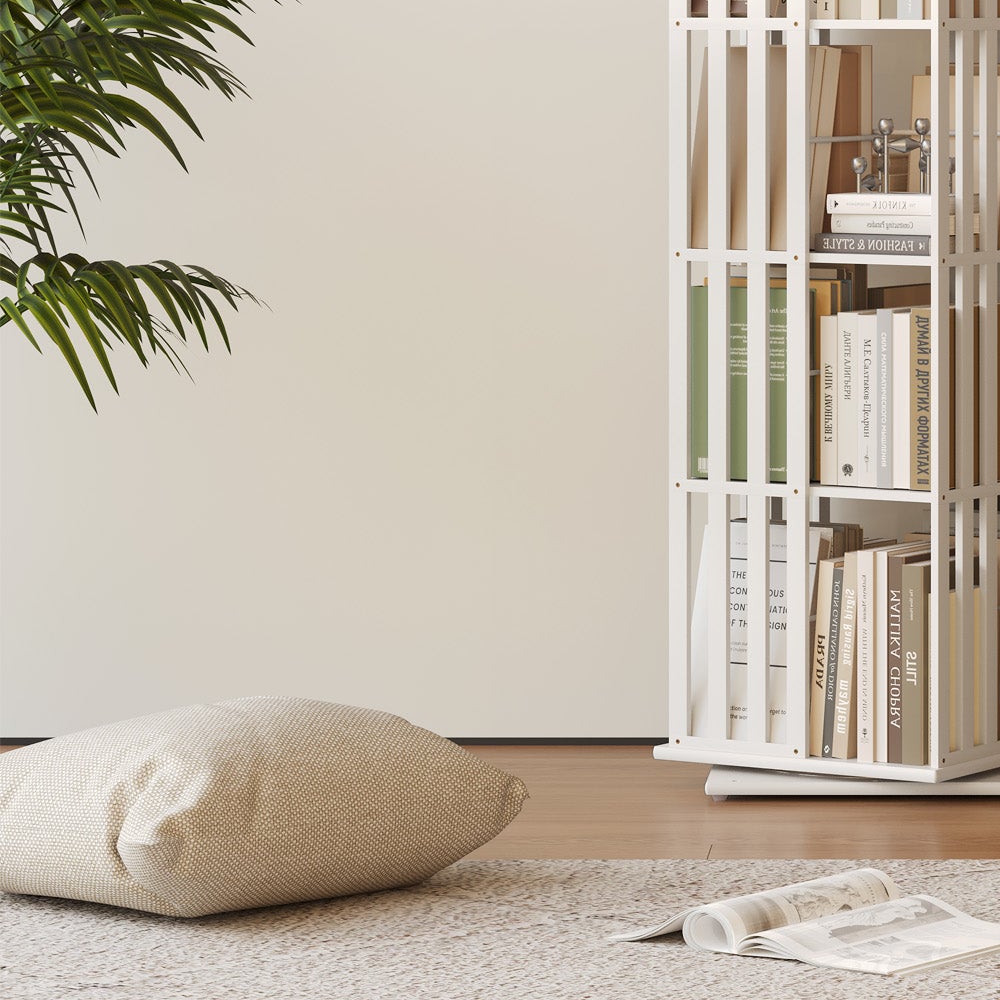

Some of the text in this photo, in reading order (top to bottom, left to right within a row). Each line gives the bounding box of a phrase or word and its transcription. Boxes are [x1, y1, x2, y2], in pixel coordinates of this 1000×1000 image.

[843, 330, 852, 358] ДАНТЕ
[915, 315, 932, 355] ДУМАЙ
[916, 358, 930, 366] В
[915, 368, 930, 413] ДРУГИХ
[824, 393, 833, 435] ВЕЧНОМУ
[916, 415, 930, 475] ФОРМАТАХ
[732, 570, 747, 580] THE
